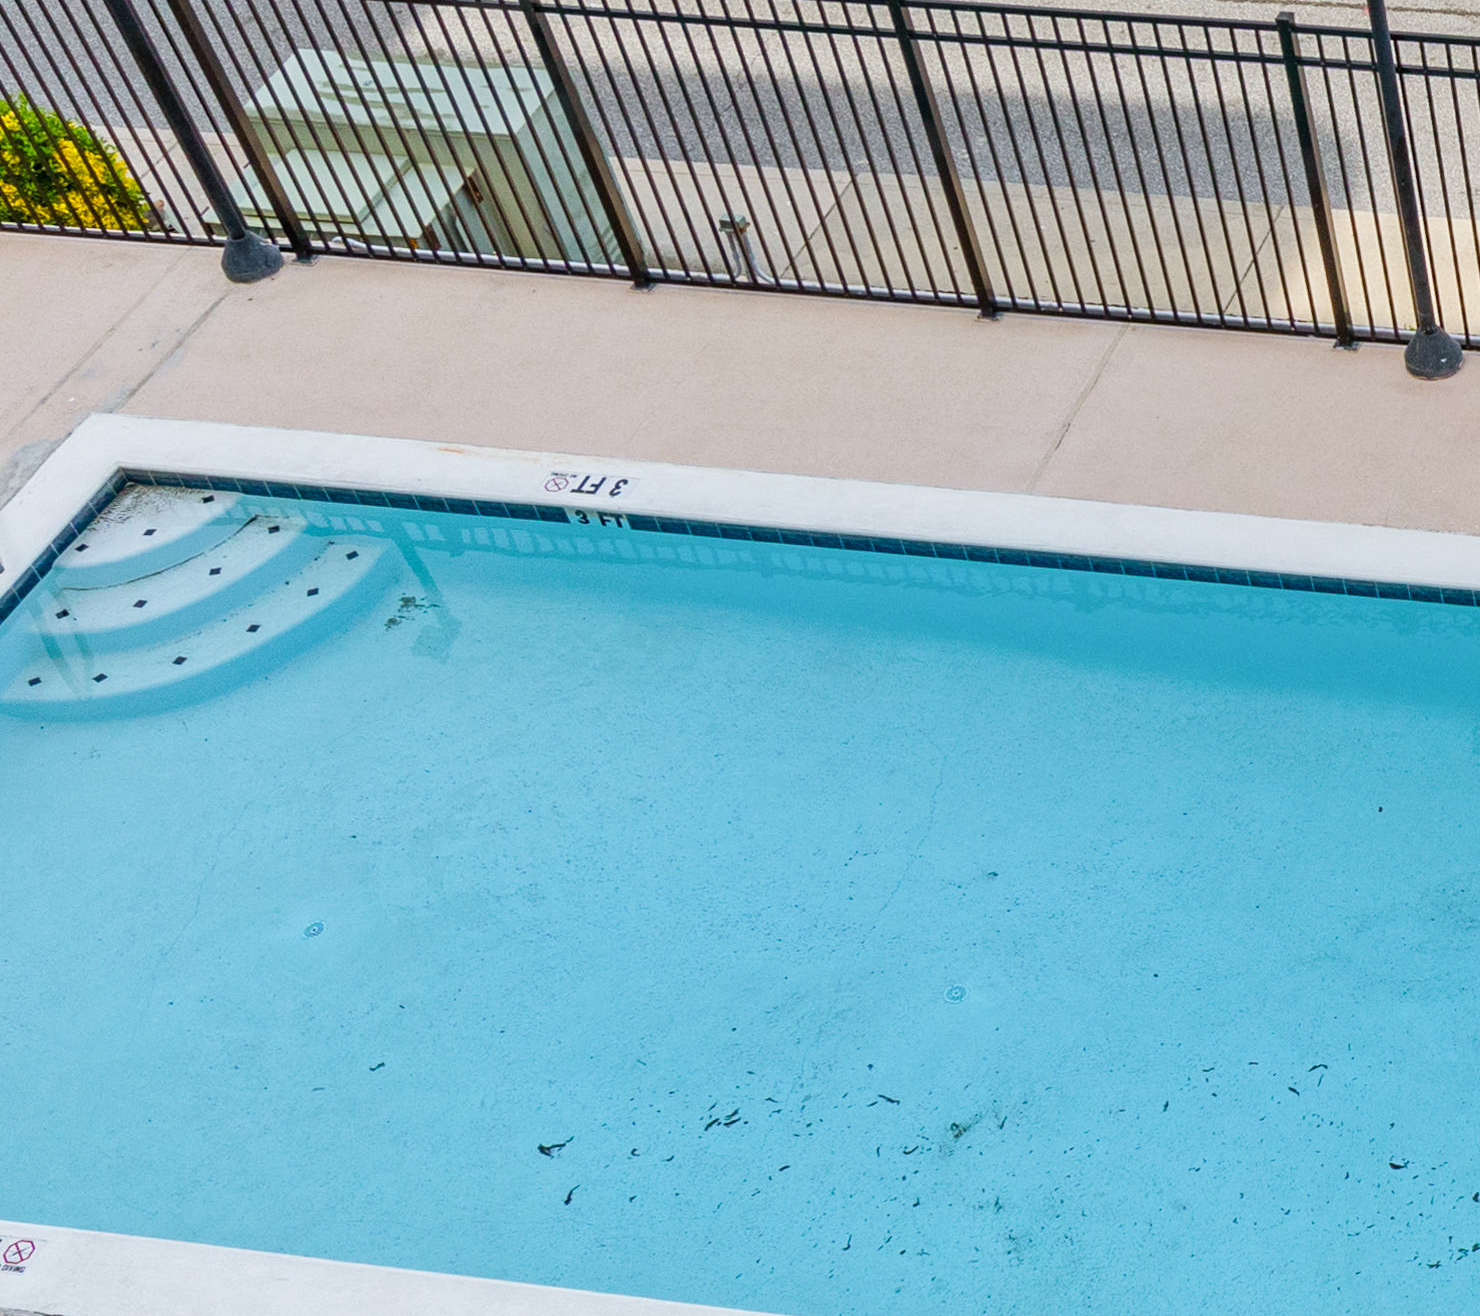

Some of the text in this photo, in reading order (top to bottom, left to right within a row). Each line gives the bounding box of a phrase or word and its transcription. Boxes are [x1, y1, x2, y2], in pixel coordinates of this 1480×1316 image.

[570, 475, 628, 497] 3 FT
[575, 509, 624, 528] 3 FT
[1, 1265, 26, 1273] DIVING
